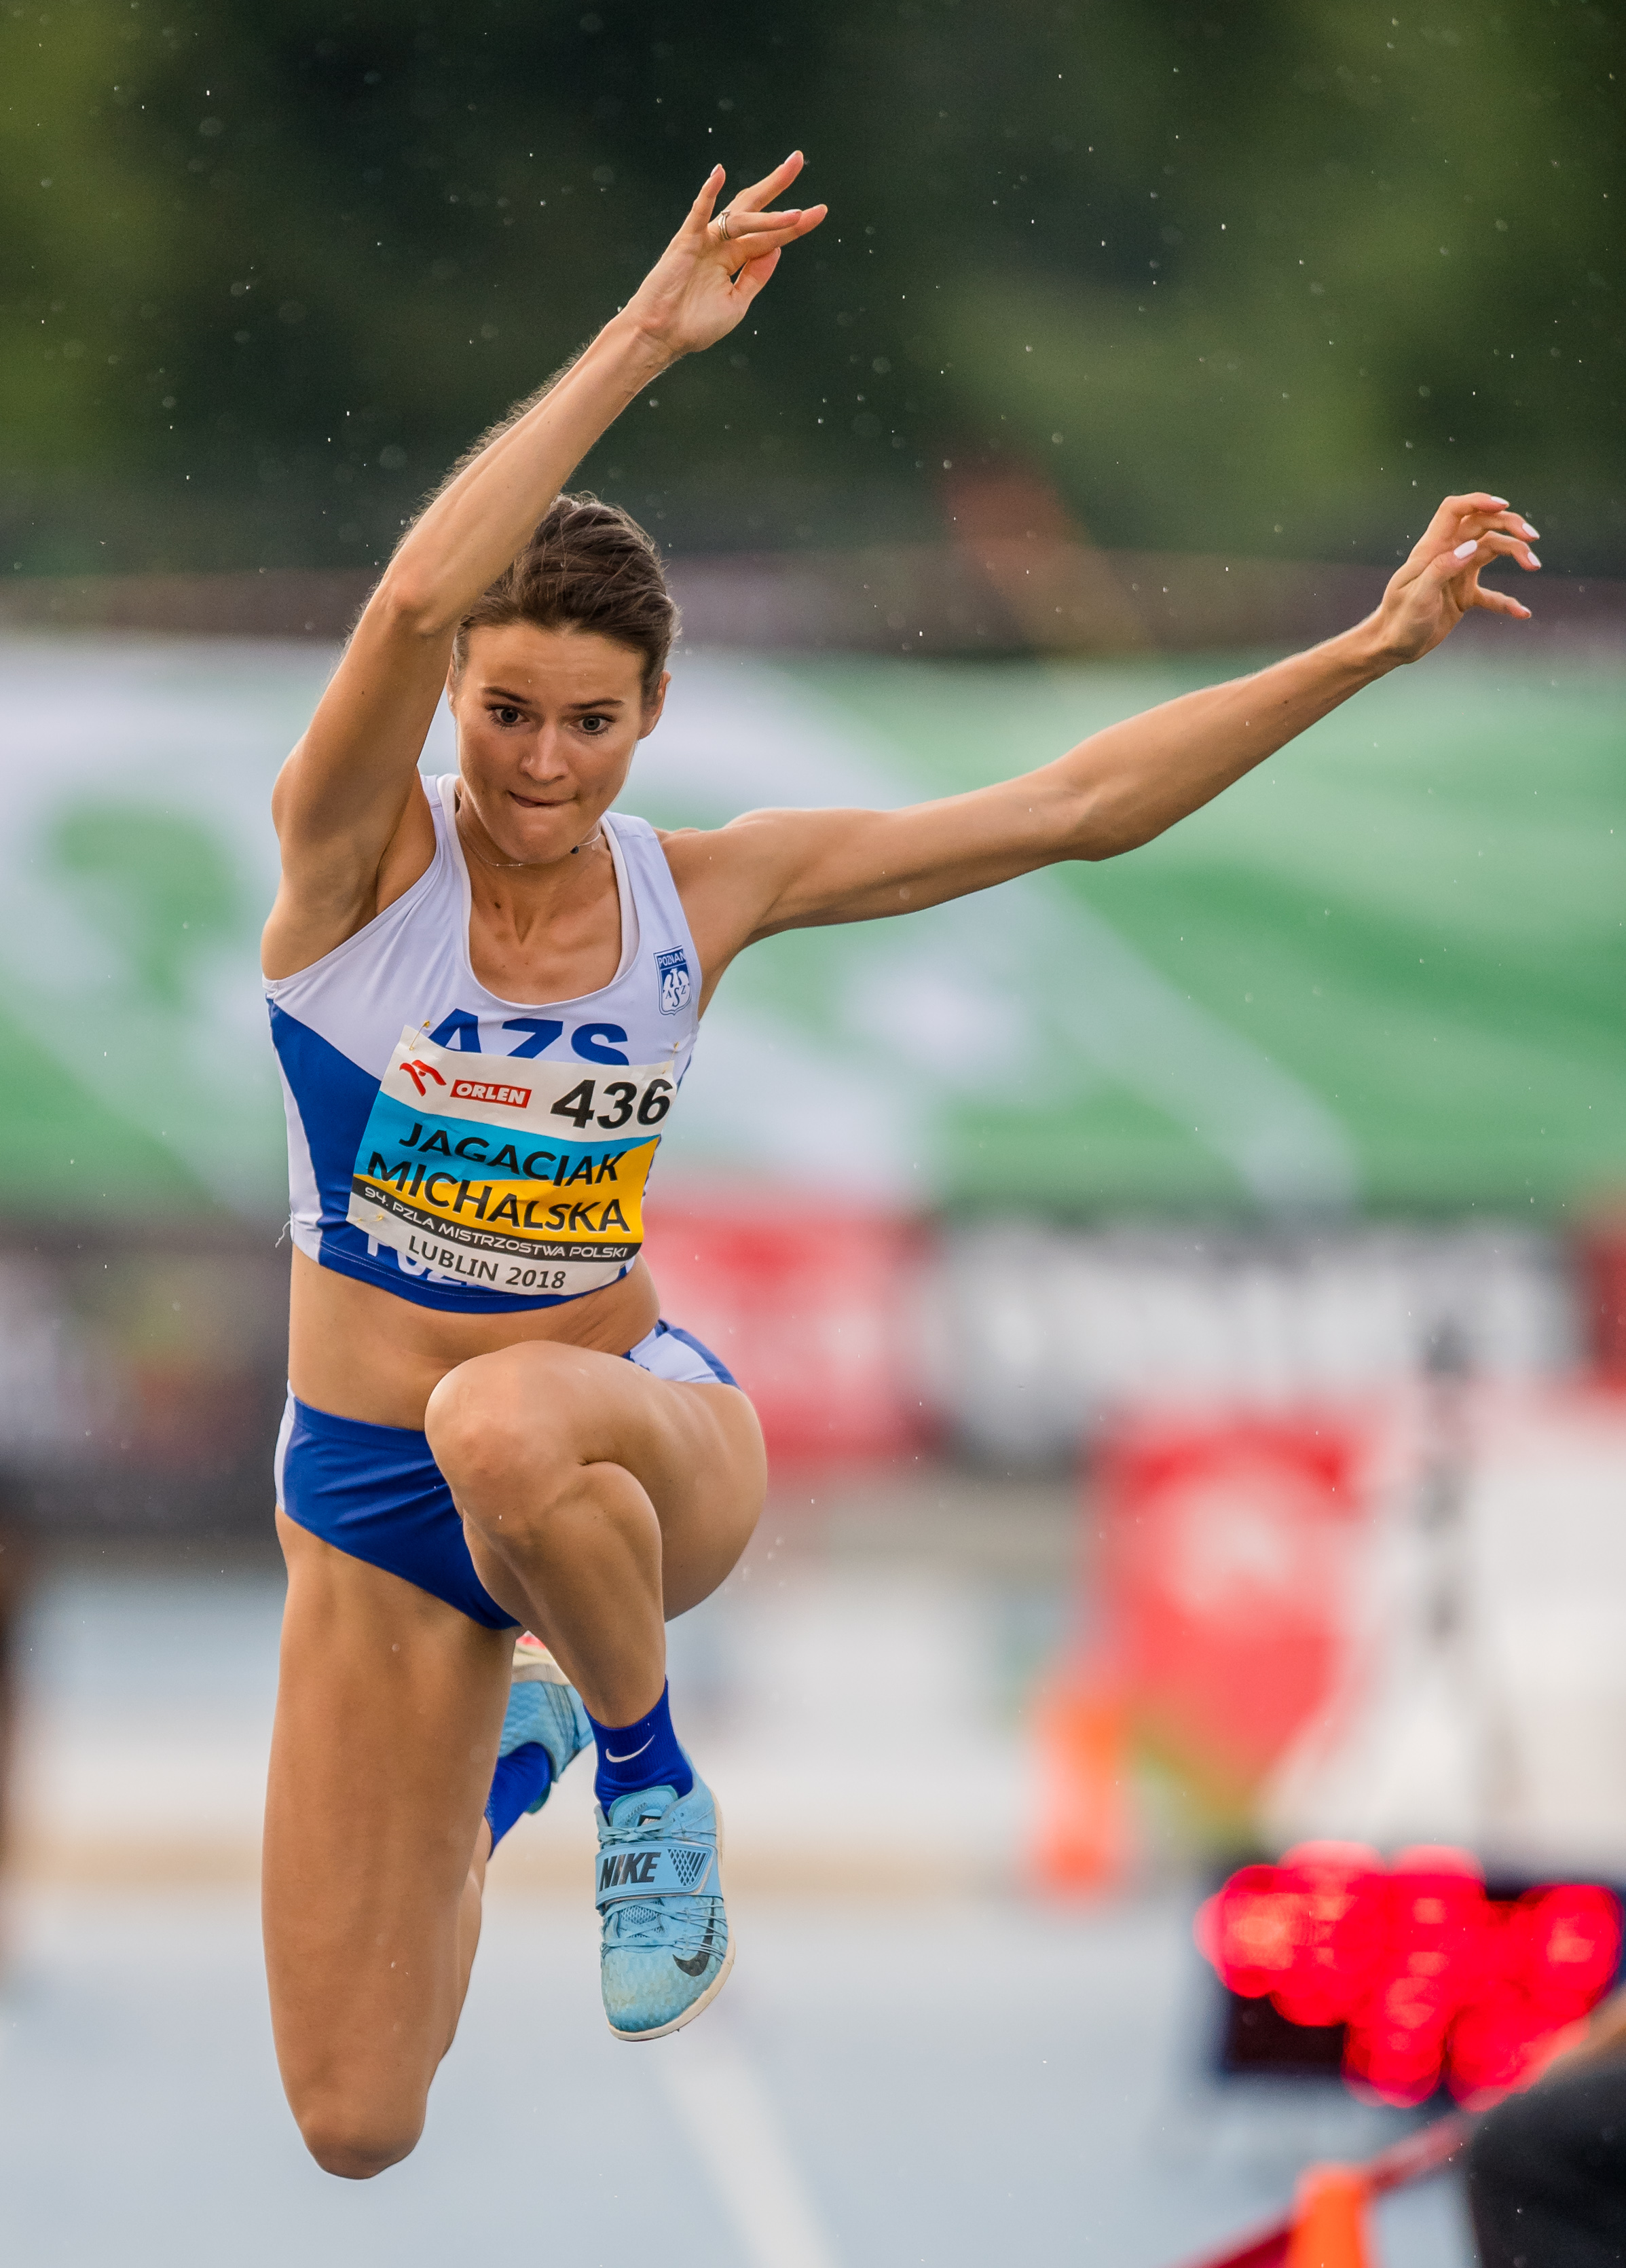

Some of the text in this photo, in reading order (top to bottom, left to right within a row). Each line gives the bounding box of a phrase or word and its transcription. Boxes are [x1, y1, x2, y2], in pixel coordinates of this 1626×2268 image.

[456, 1083, 526, 1105] ORLEN
[550, 1078, 673, 1130] 436
[399, 1122, 627, 1187] JAGACIAK
[367, 1151, 631, 1233] MICHALSKA
[365, 1186, 628, 1258] 94. PZLA MISTRZOSTWA POLSKI
[409, 1234, 499, 1281] LUBLIN
[505, 1266, 566, 1289] 2018
[598, 1852, 661, 1892] NIKE
